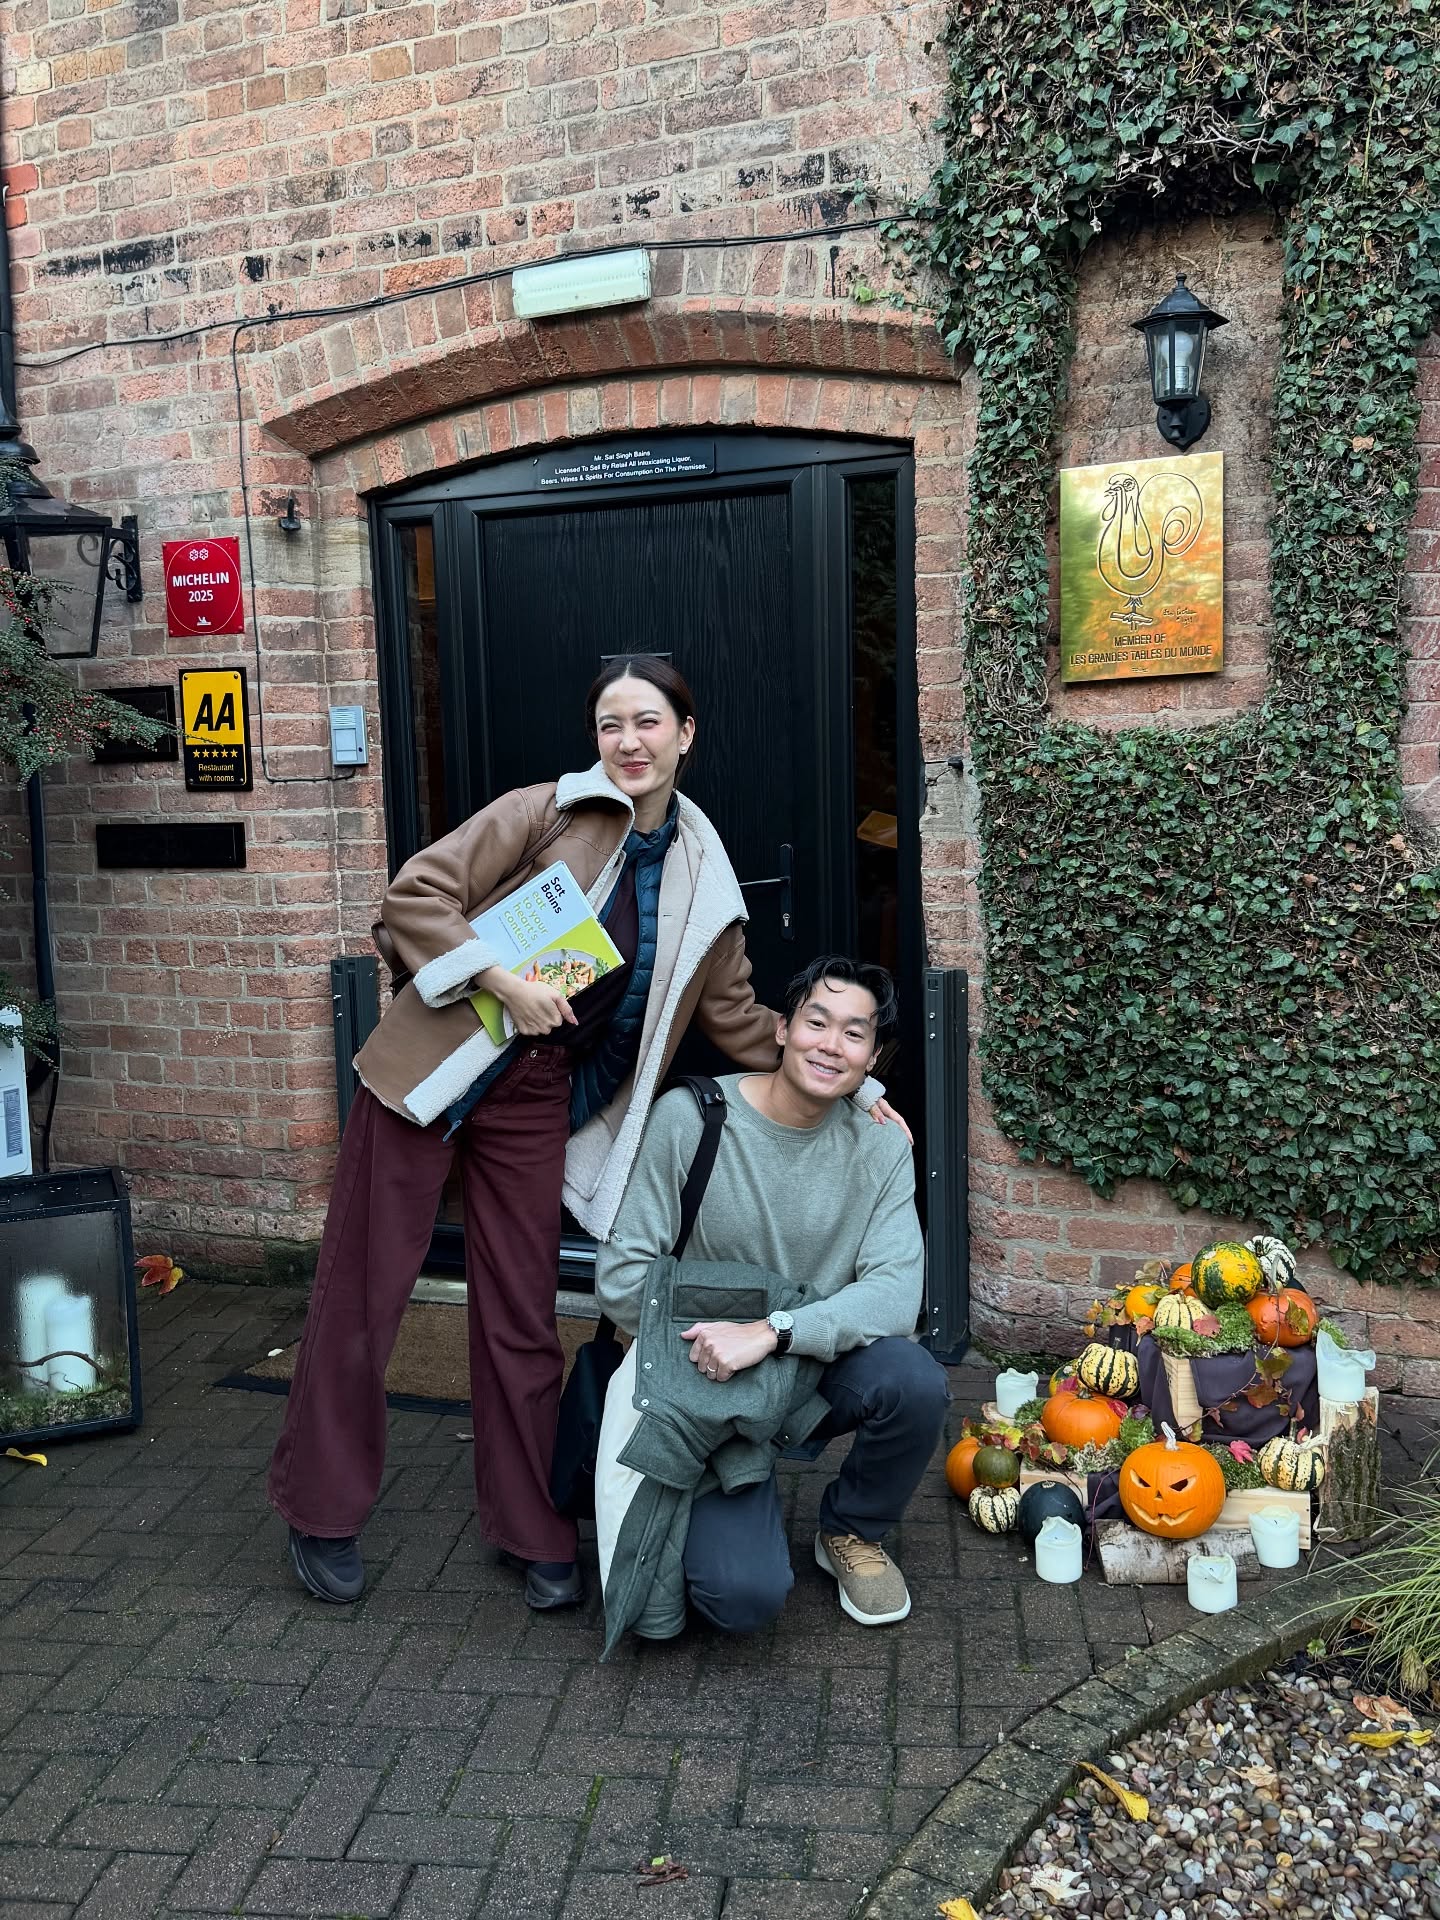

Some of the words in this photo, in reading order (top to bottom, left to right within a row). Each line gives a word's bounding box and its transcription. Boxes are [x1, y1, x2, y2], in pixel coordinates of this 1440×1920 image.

[616, 451, 633, 460] Singh
[633, 450, 651, 458] Bains
[554, 466, 580, 475] Licensed
[601, 463, 610, 471] By
[610, 461, 628, 469] Retail
[637, 457, 671, 466] Intoxicating
[585, 473, 603, 481] Spirits
[614, 467, 653, 478] Consumption
[172, 571, 230, 588] MICHELIN
[188, 589, 214, 603] 2025
[1114, 634, 1152, 648] MEMBER
[1153, 633, 1167, 644] OF
[1070, 654, 1087, 667] LES
[1088, 651, 1129, 664] GRANDES
[1130, 648, 1163, 662] TABLES
[1164, 647, 1178, 659] DU
[1179, 644, 1213, 657] MONDE
[192, 692, 236, 732] AA
[198, 762, 234, 772] Restaurant
[198, 774, 213, 782] with
[213, 774, 235, 782] rooms
[550, 876, 566, 898] Sat
[532, 891, 547, 911] eat
[540, 883, 562, 914] Bains
[513, 902, 538, 942] heart's
[522, 896, 532, 910] to
[528, 910, 549, 935] your
[503, 910, 532, 951] content
